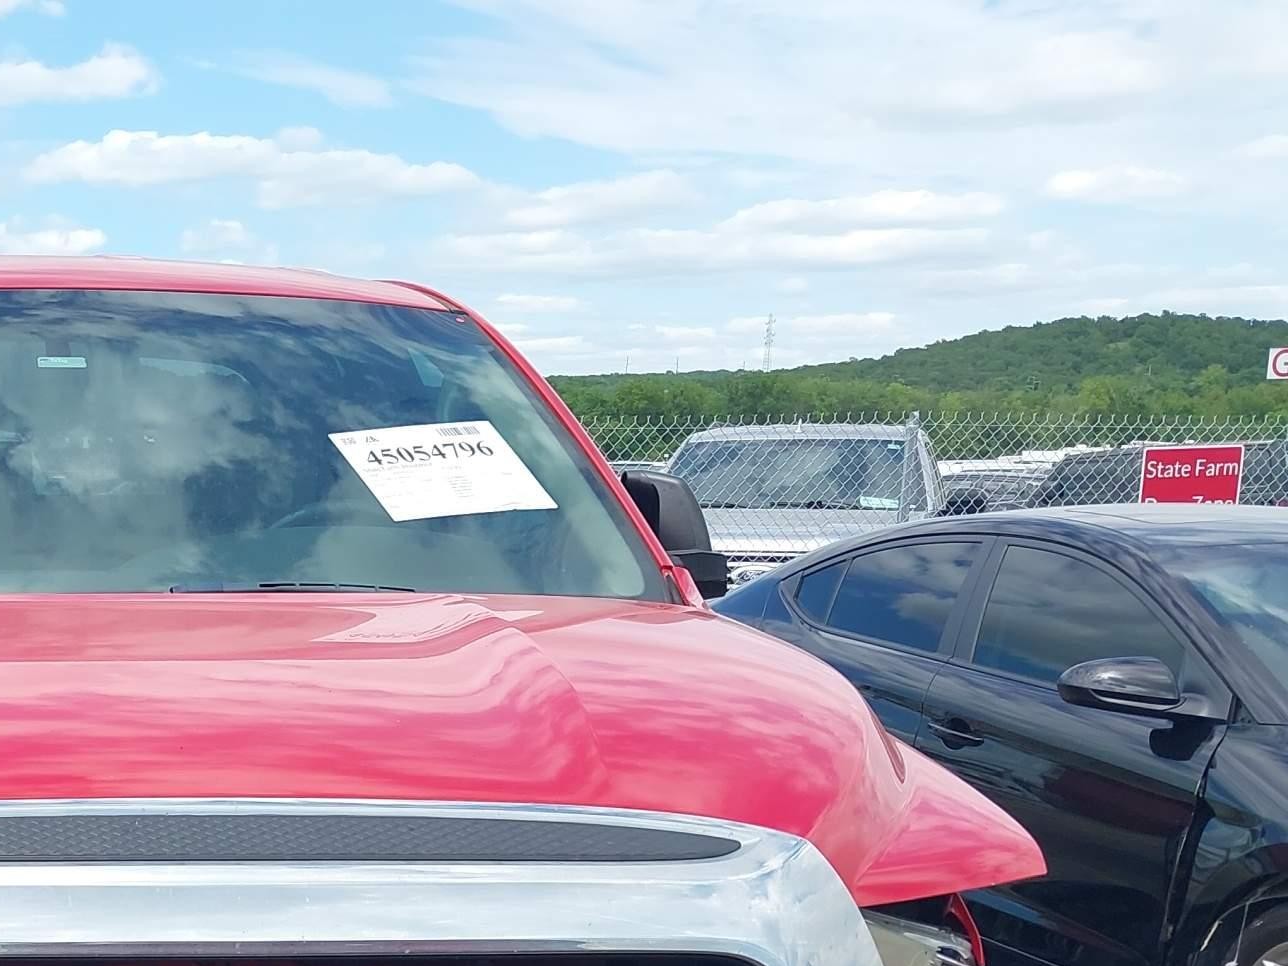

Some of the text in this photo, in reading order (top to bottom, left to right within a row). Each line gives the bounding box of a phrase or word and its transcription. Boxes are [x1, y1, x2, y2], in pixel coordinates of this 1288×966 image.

[367, 440, 494, 466] 45054796
[1146, 459, 1239, 479] State Farm
